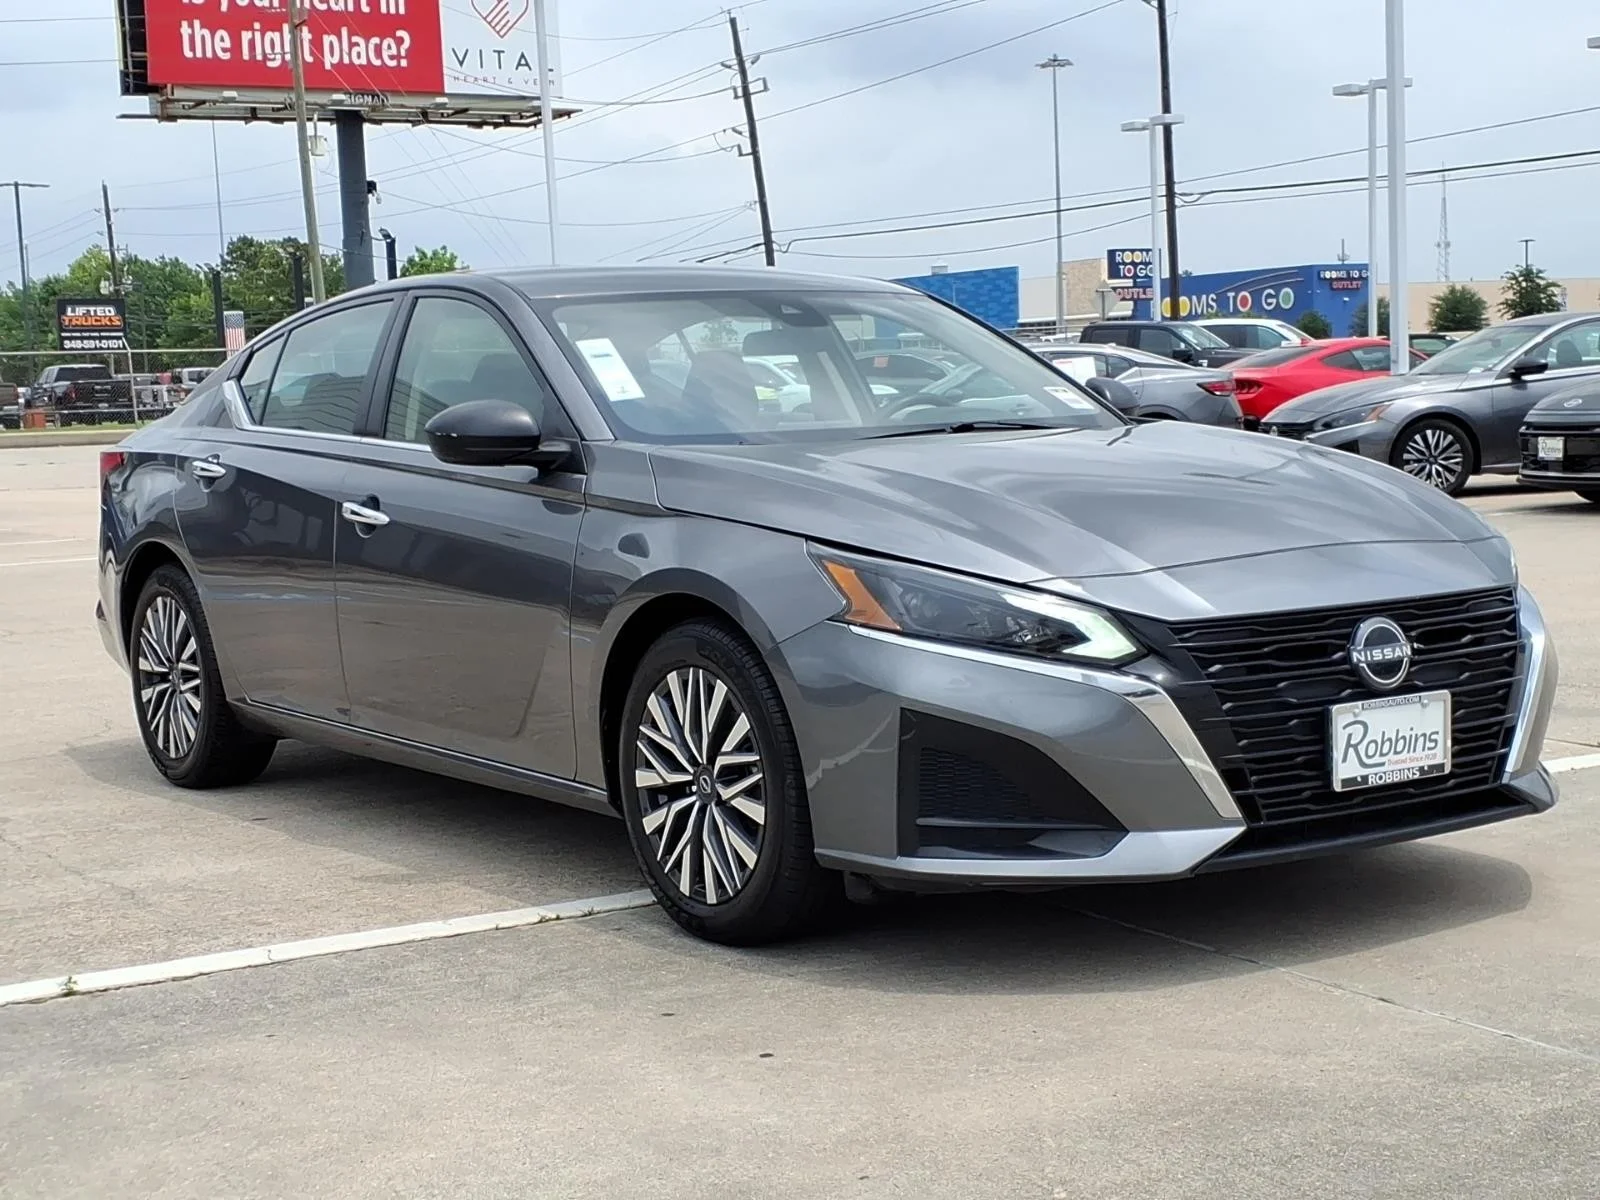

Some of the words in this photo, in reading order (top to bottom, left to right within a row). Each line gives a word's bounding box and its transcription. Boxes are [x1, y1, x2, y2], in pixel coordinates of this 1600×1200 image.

[180, 19, 231, 60] the
[322, 26, 411, 70] place?
[451, 47, 554, 72] VITA
[1115, 251, 1153, 263] ROOM
[1119, 265, 1134, 277] TO
[1115, 287, 1153, 299] OUTLE
[1227, 291, 1252, 313] TO
[1262, 286, 1294, 310] GO
[67, 307, 115, 316] LIFTED
[63, 316, 121, 326] TRUCKS
[1353, 645, 1411, 662] NISSAN
[1341, 719, 1440, 769] Robbins
[1368, 767, 1420, 785] ROBBINS
